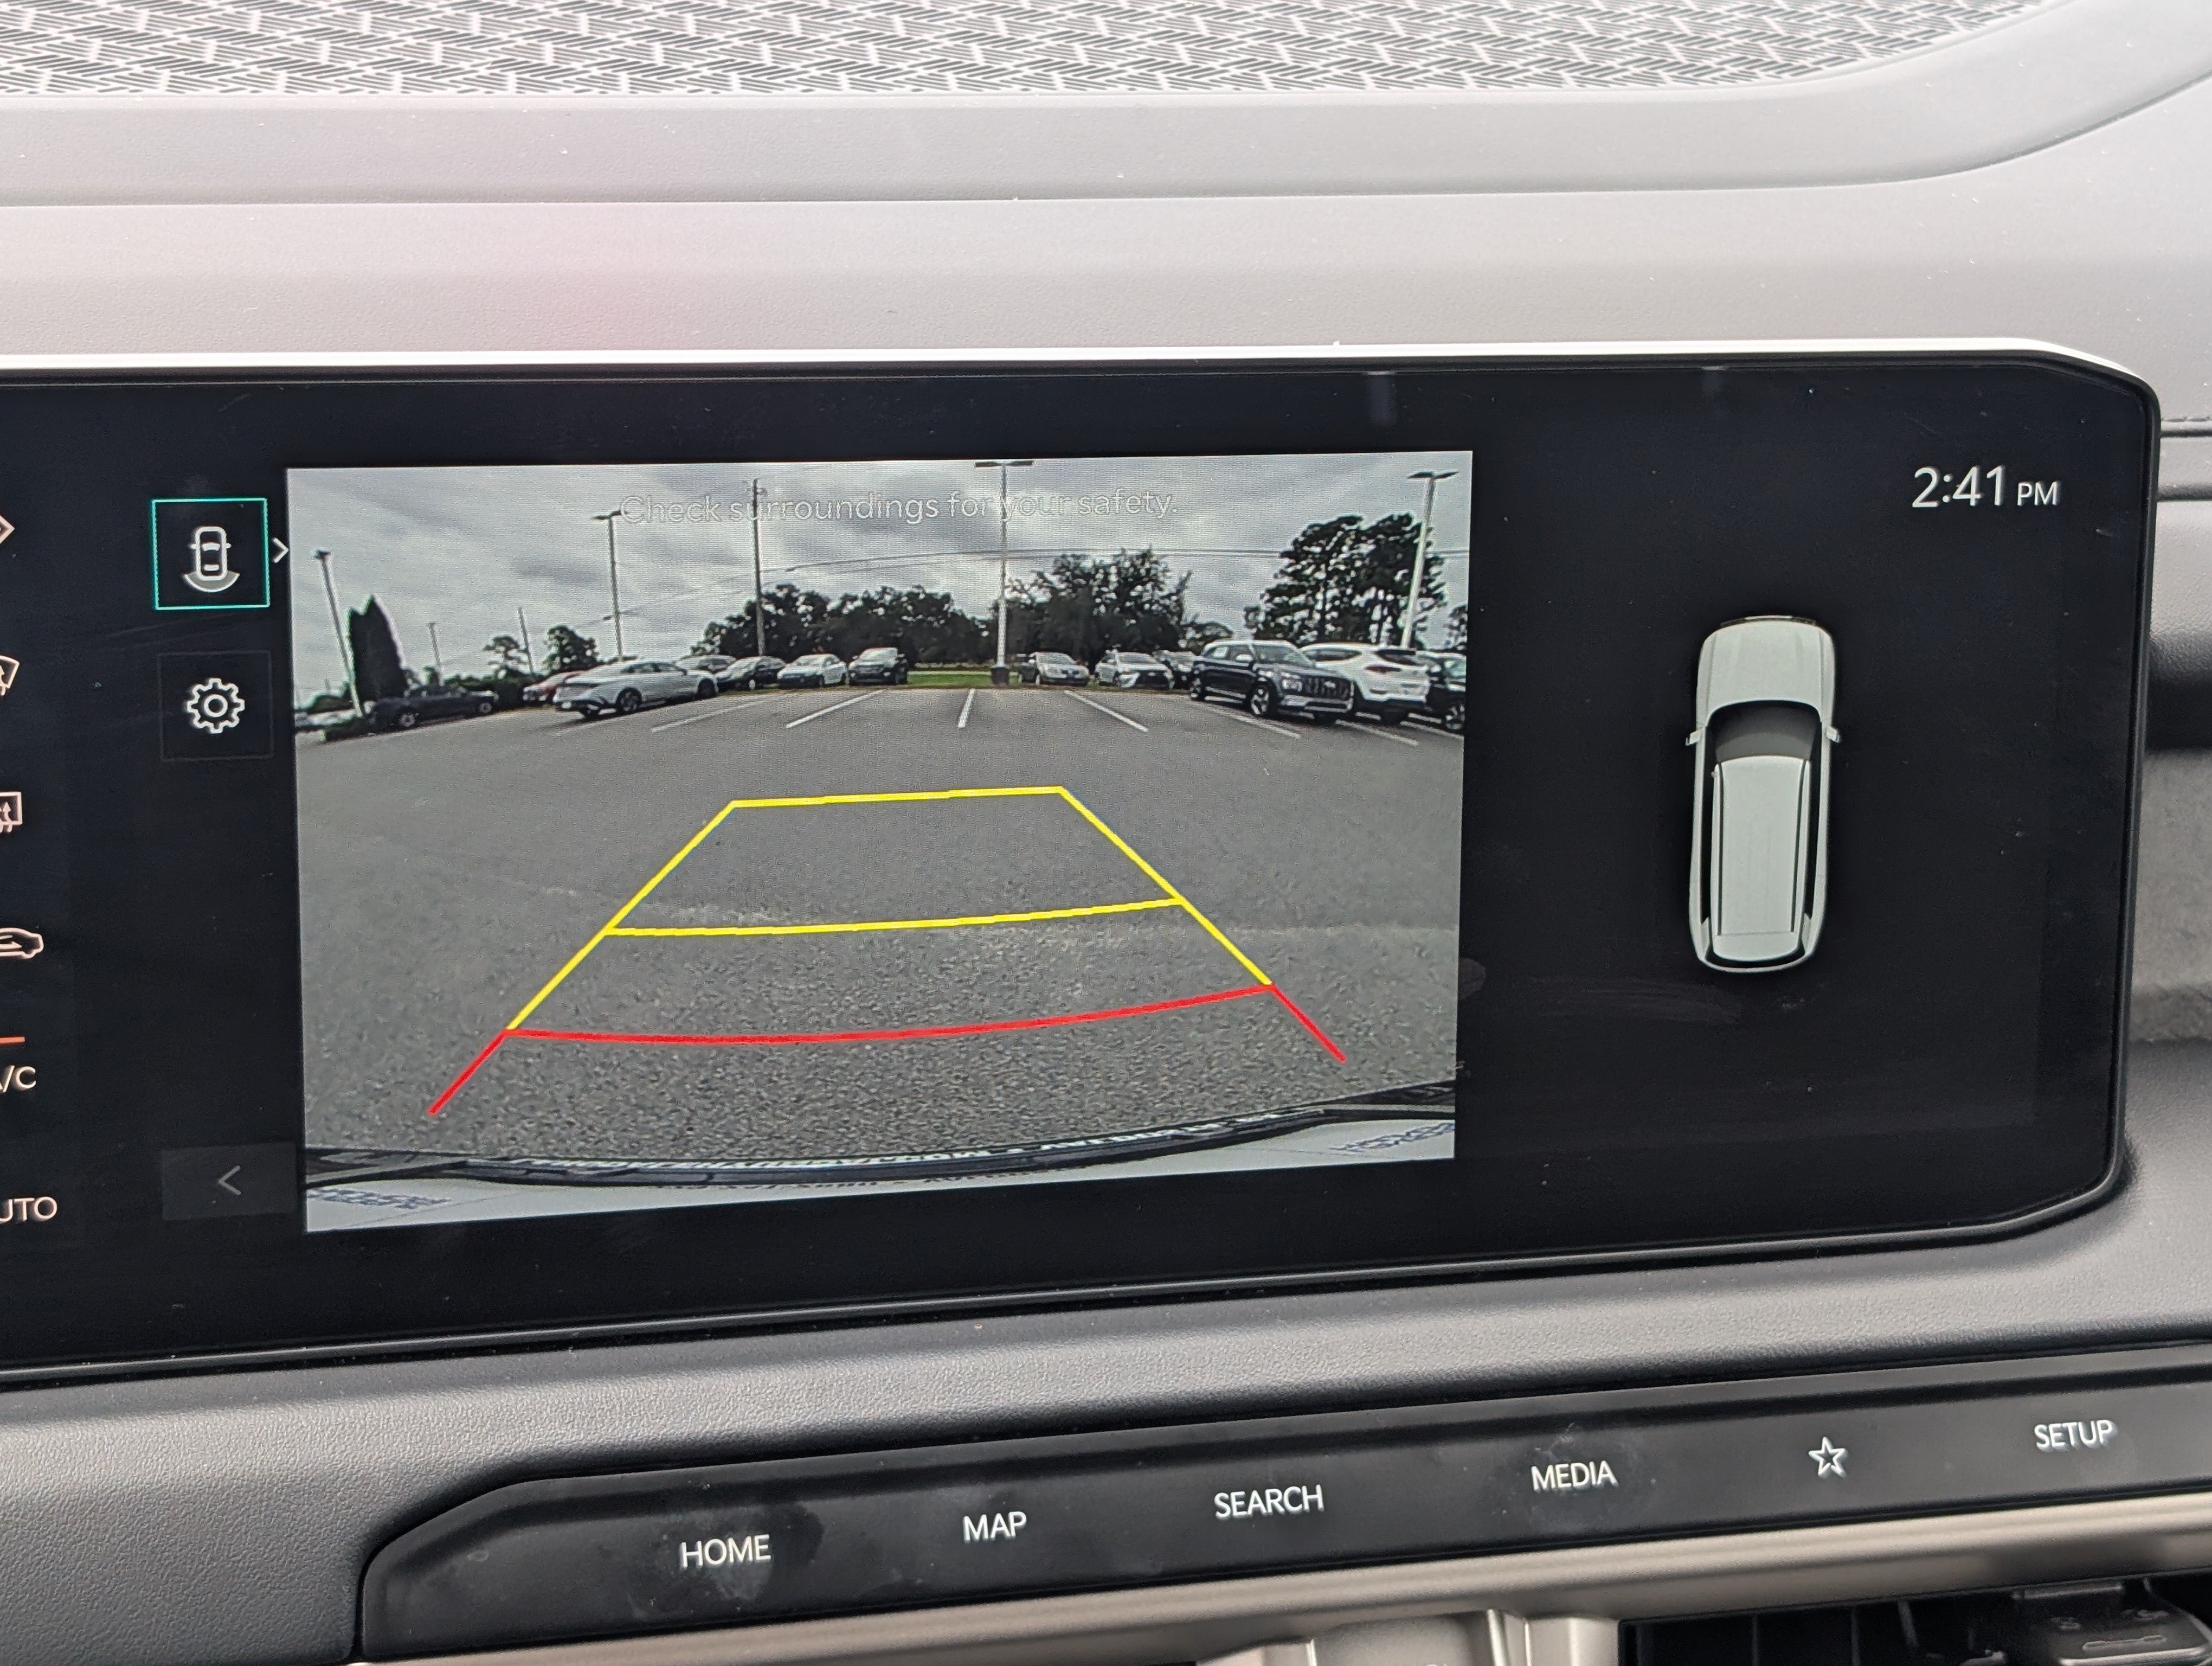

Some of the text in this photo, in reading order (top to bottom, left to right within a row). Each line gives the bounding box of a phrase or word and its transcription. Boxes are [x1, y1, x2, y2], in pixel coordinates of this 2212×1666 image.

[1912, 465, 2061, 508] 2:41 PM
[621, 488, 1179, 524] Check surroundings for your safety.
[0, 1065, 37, 1093] /C
[0, 1196, 58, 1222] UTO
[2033, 1419, 2115, 1451] SETUP
[1531, 1460, 1618, 1492] MEDIA
[1213, 1484, 1324, 1518] SEARCH
[963, 1510, 1027, 1543] MAP
[679, 1534, 772, 1568] HOME
